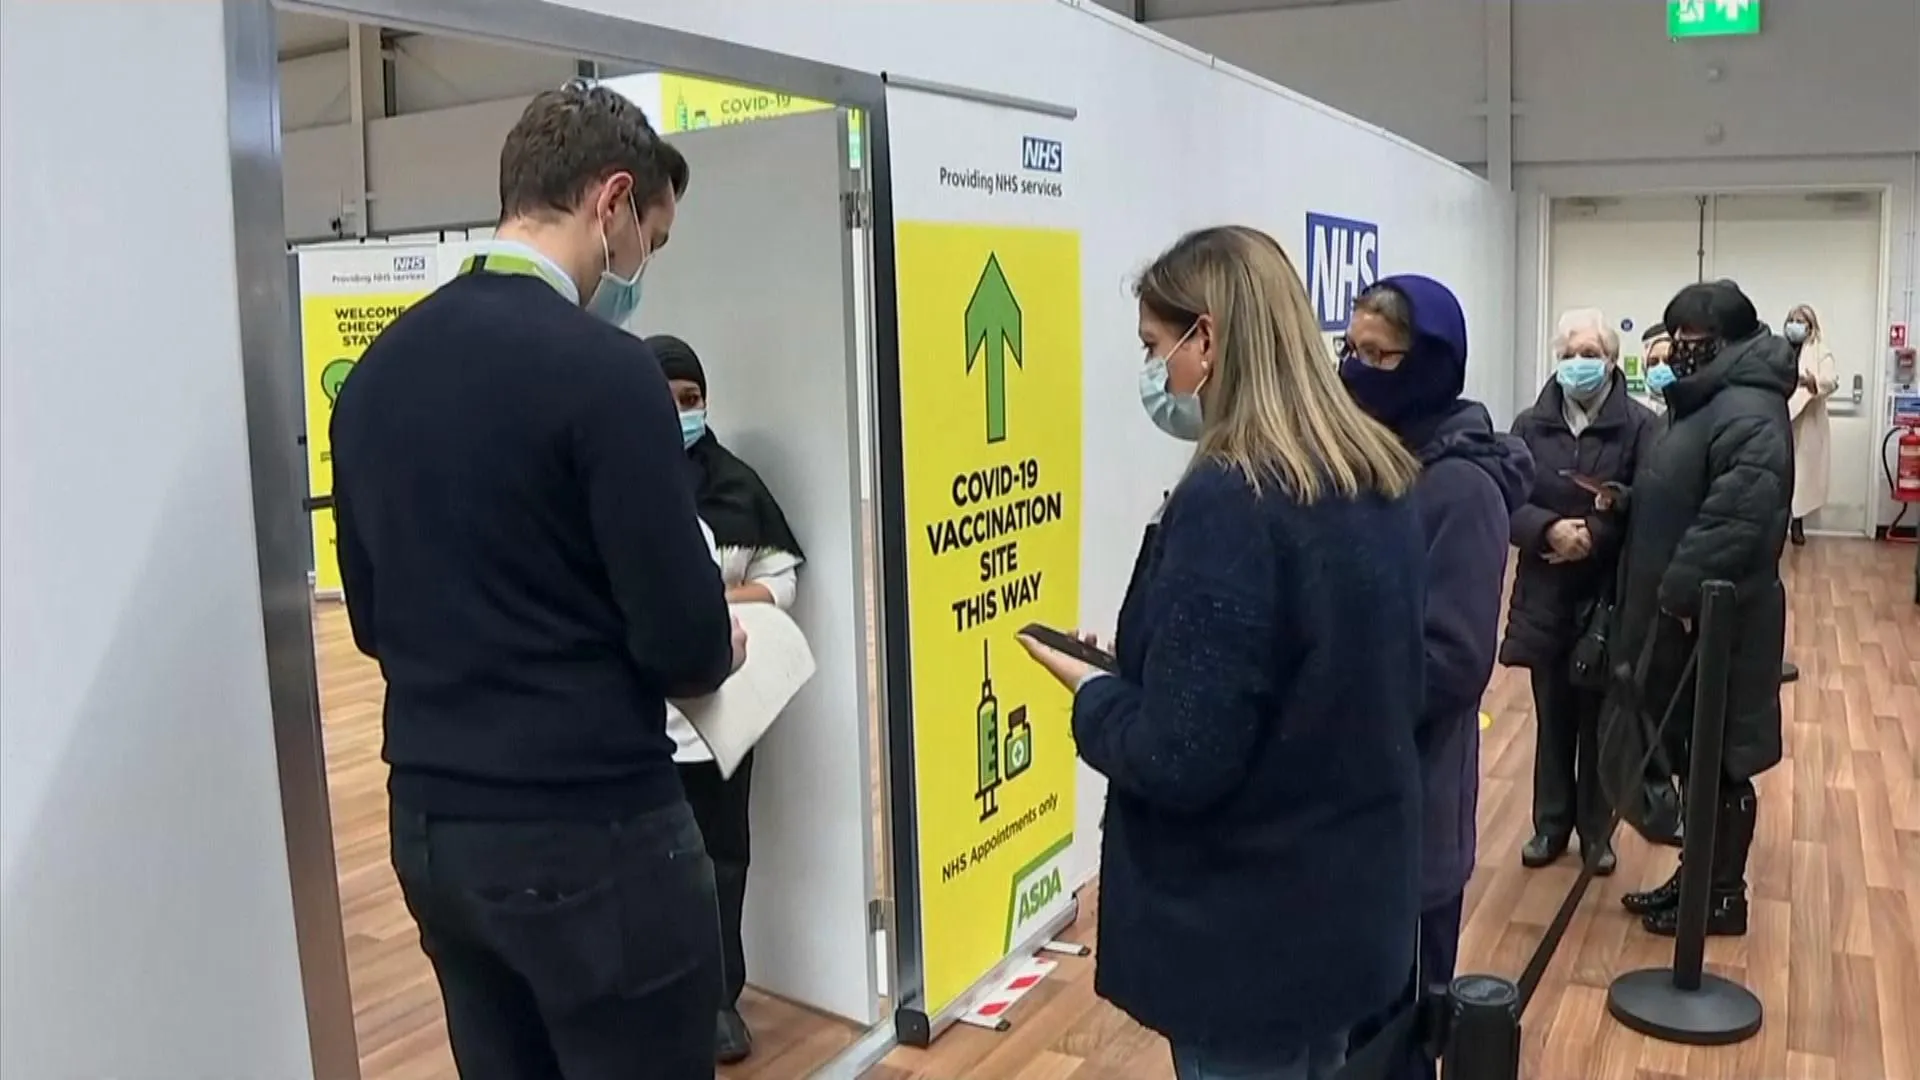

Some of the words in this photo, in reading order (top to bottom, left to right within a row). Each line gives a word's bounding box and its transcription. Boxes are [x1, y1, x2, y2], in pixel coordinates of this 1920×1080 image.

[940, 166, 994, 195] Providing
[995, 173, 1018, 194] NHS
[1021, 177, 1062, 198] services
[1023, 138, 1061, 171] NHS
[395, 256, 425, 271] NHS
[1310, 224, 1376, 322] NHS
[952, 458, 1039, 507] COVID-19
[926, 491, 1062, 557] VACCINATION
[980, 541, 1018, 583] SITE
[952, 589, 998, 633] THIS
[1001, 571, 1043, 614] WAY
[942, 852, 968, 884] NHS
[969, 808, 1037, 867] Appointments
[1038, 792, 1059, 817] only
[1018, 866, 1063, 929] ASDA
